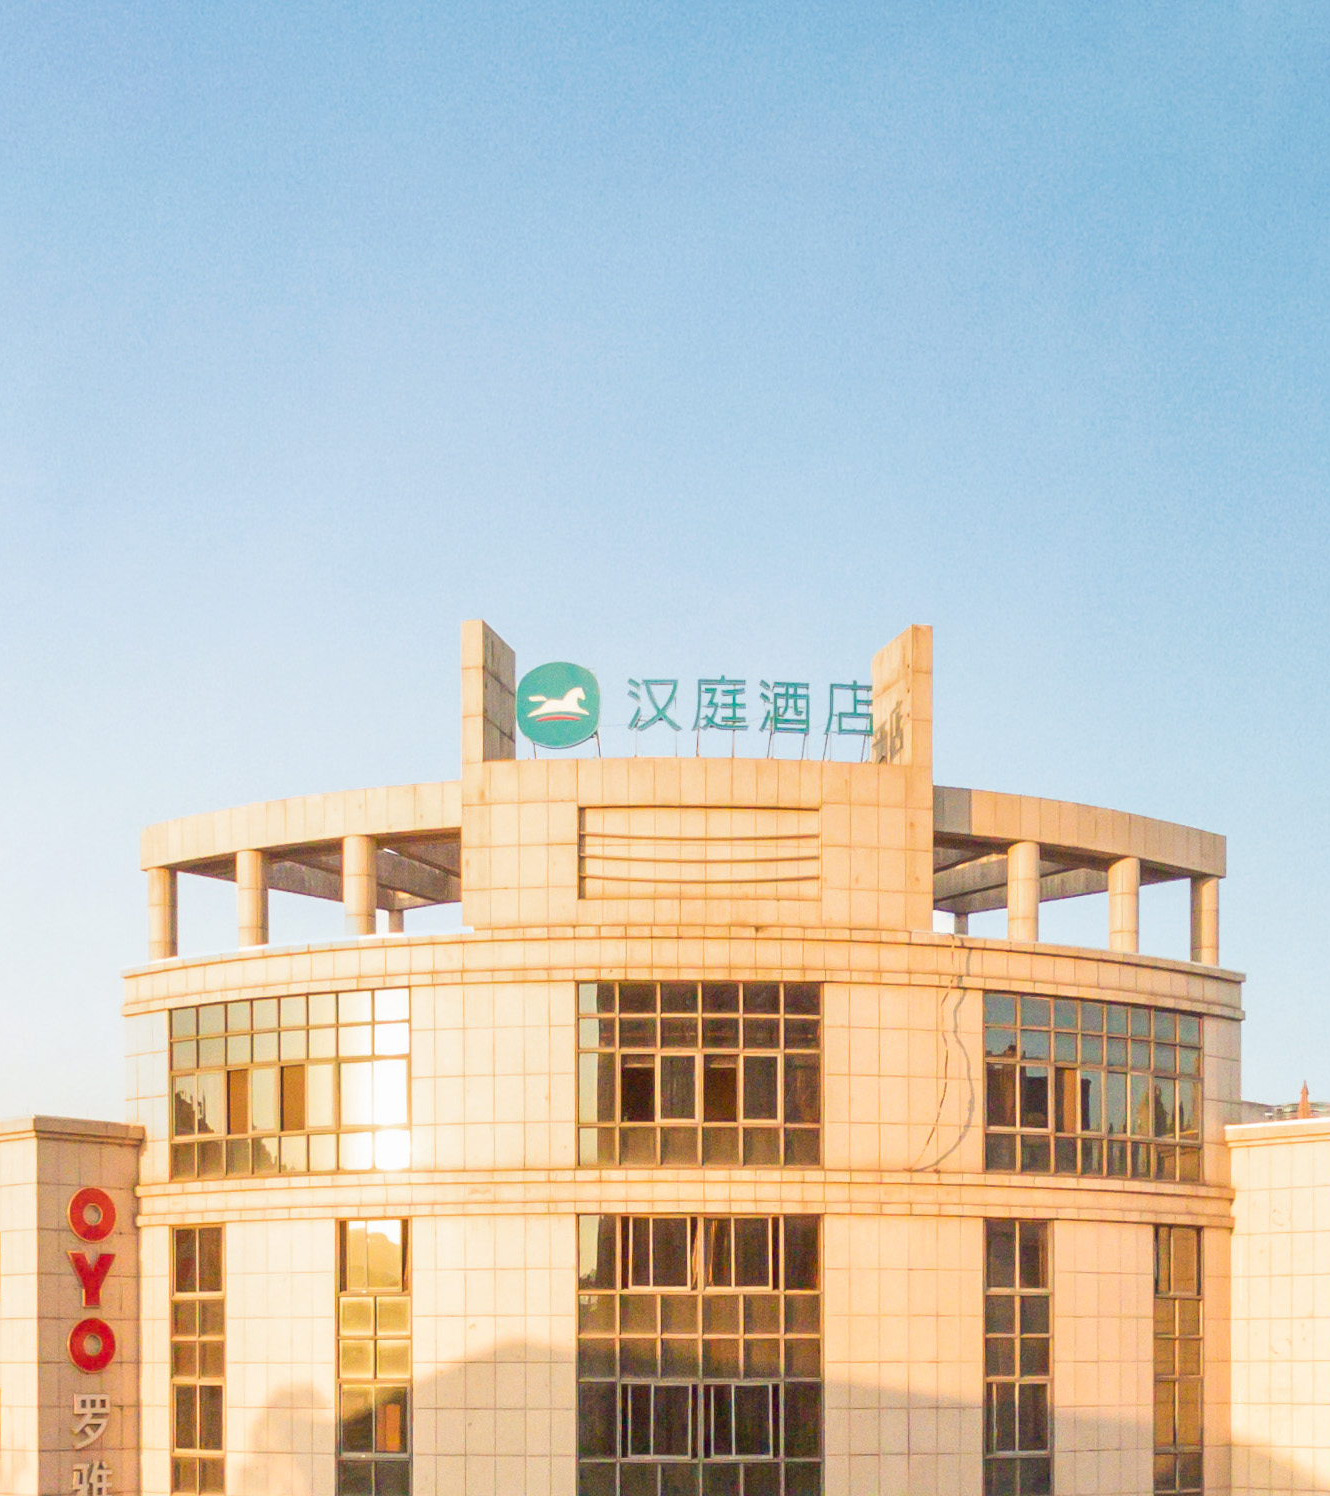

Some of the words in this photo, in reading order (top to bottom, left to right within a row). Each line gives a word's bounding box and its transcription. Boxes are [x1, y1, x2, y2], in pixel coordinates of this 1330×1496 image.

[627, 674, 873, 736] 汉庭酒店
[66, 1186, 117, 1374] OYO
